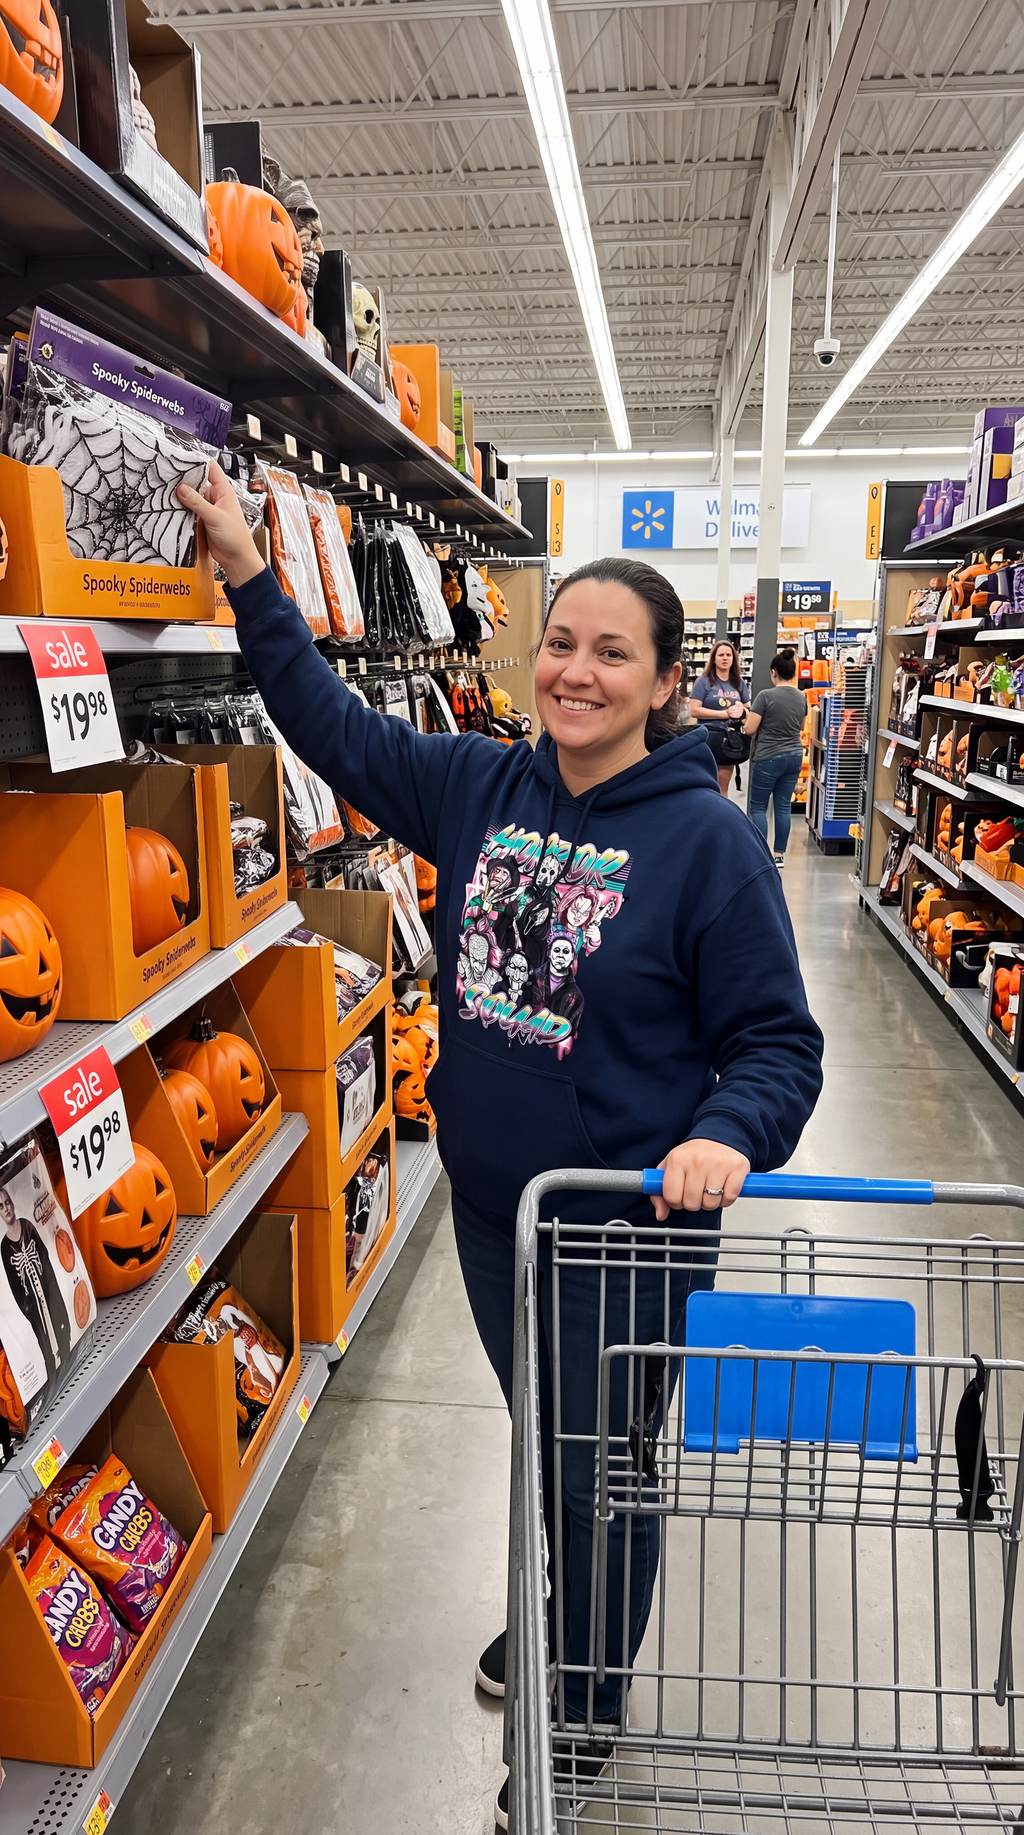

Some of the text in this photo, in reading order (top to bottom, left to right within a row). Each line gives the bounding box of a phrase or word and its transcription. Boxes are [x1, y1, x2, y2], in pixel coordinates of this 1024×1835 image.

[92, 362, 185, 416] Spooky Spiderwebs
[706, 499, 760, 517] Wlm
[705, 521, 759, 538] Dlive
[83, 574, 191, 597] Spooky Spiderwebs
[45, 630, 89, 669] sale
[63, 1067, 103, 1117] sale
[93, 1479, 145, 1550] CANDY
